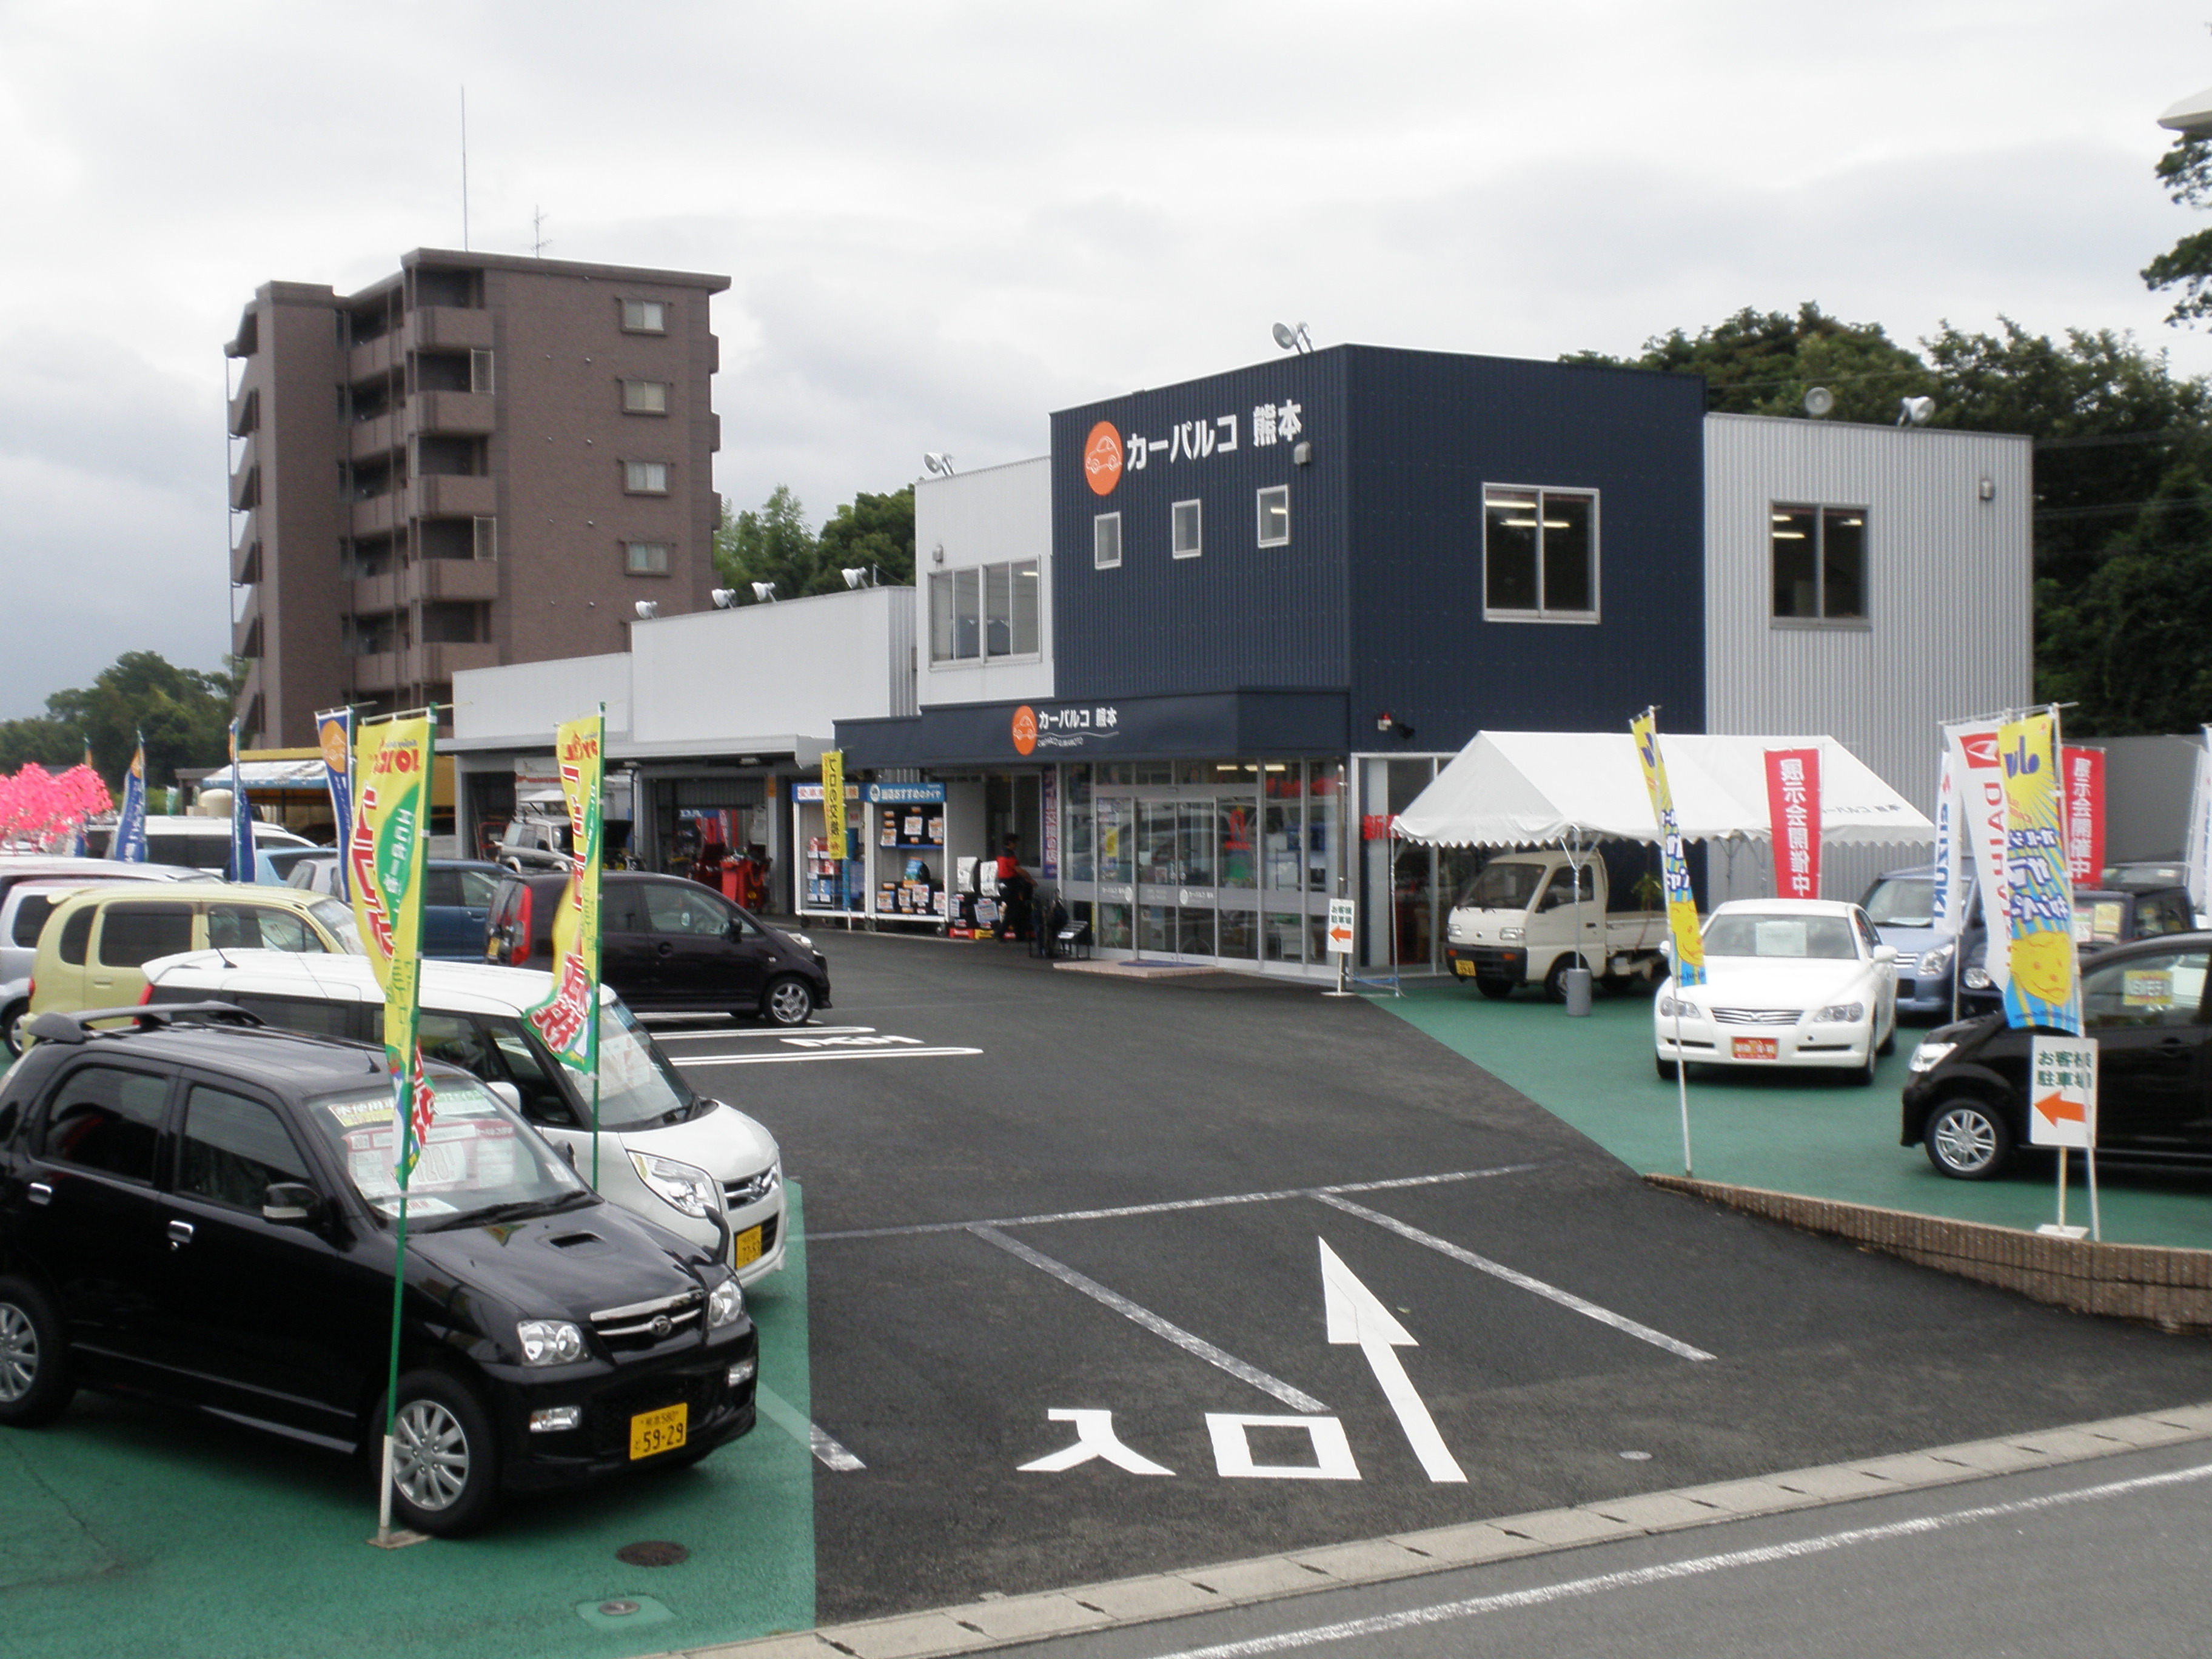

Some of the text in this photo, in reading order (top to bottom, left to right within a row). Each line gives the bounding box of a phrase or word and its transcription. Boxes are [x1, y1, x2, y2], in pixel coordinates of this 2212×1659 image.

[1127, 399, 1302, 471] カーパルコ 熊本
[1038, 709, 1091, 730] カーパルコ
[643, 1423, 683, 1452] 59-29
[1016, 1408, 1362, 1481] 入口
